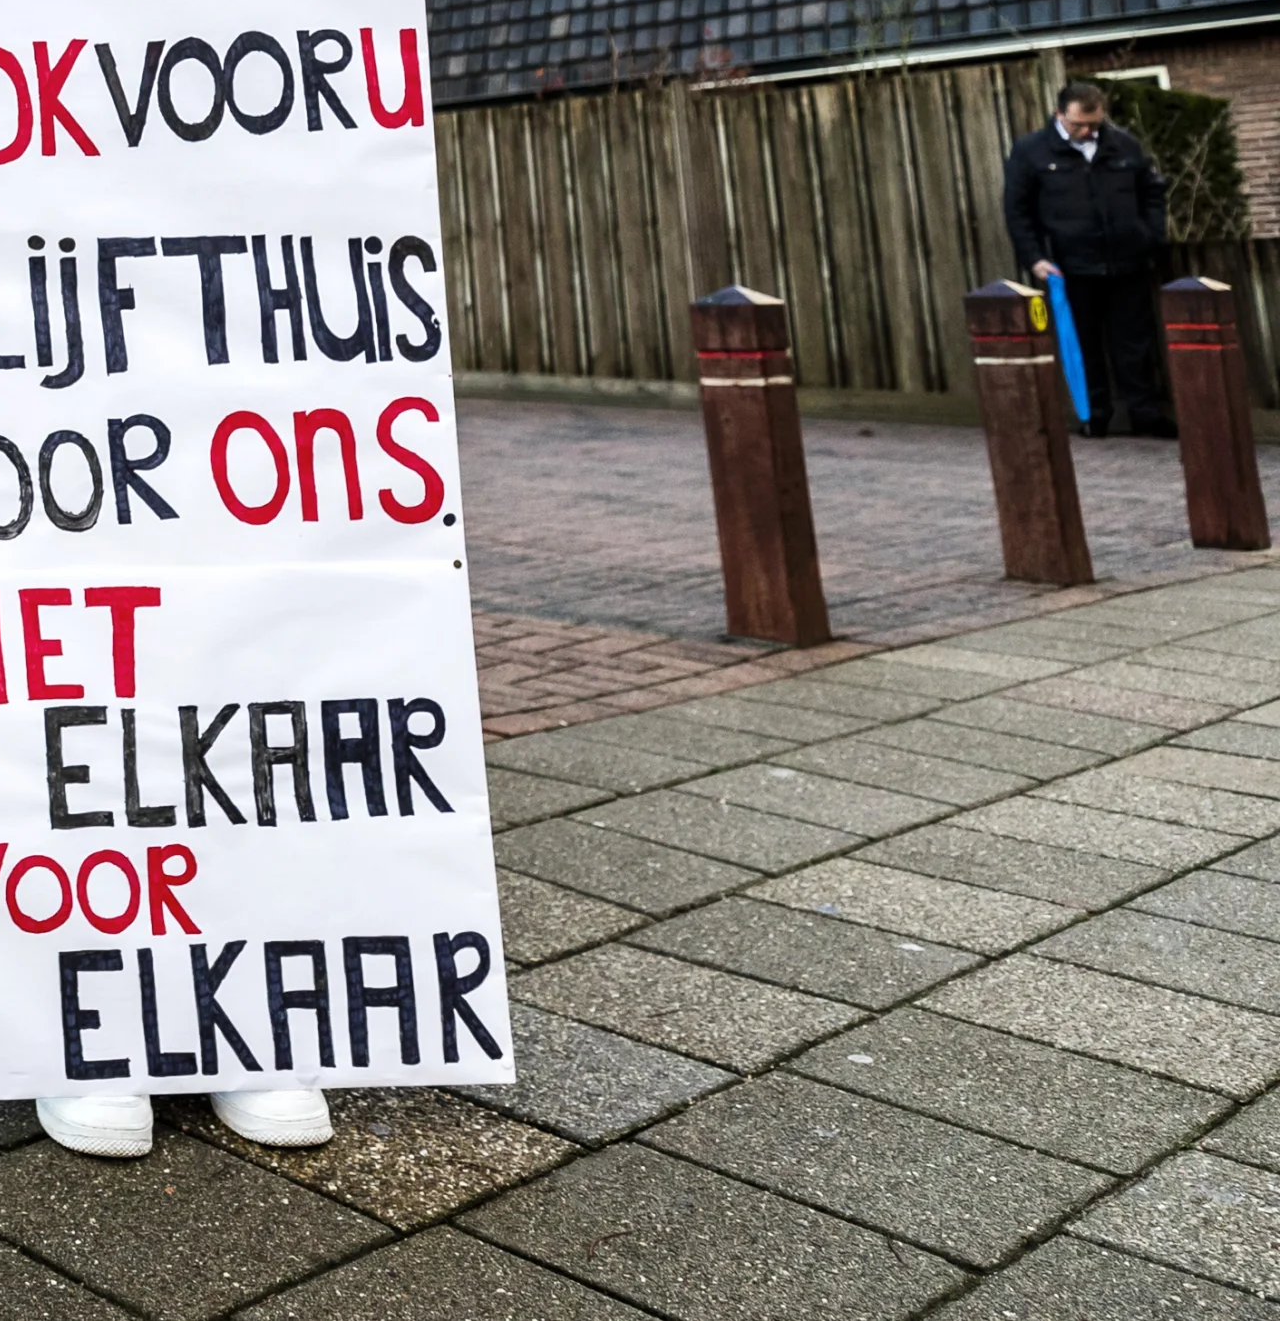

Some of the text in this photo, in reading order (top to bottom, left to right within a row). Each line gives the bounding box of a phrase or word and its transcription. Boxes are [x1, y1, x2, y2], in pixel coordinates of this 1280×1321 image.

[94, 29, 358, 148] VOOR
[359, 27, 425, 129] U
[44, 697, 455, 830] ELKAAR
[59, 931, 504, 1080] ELKAAR
